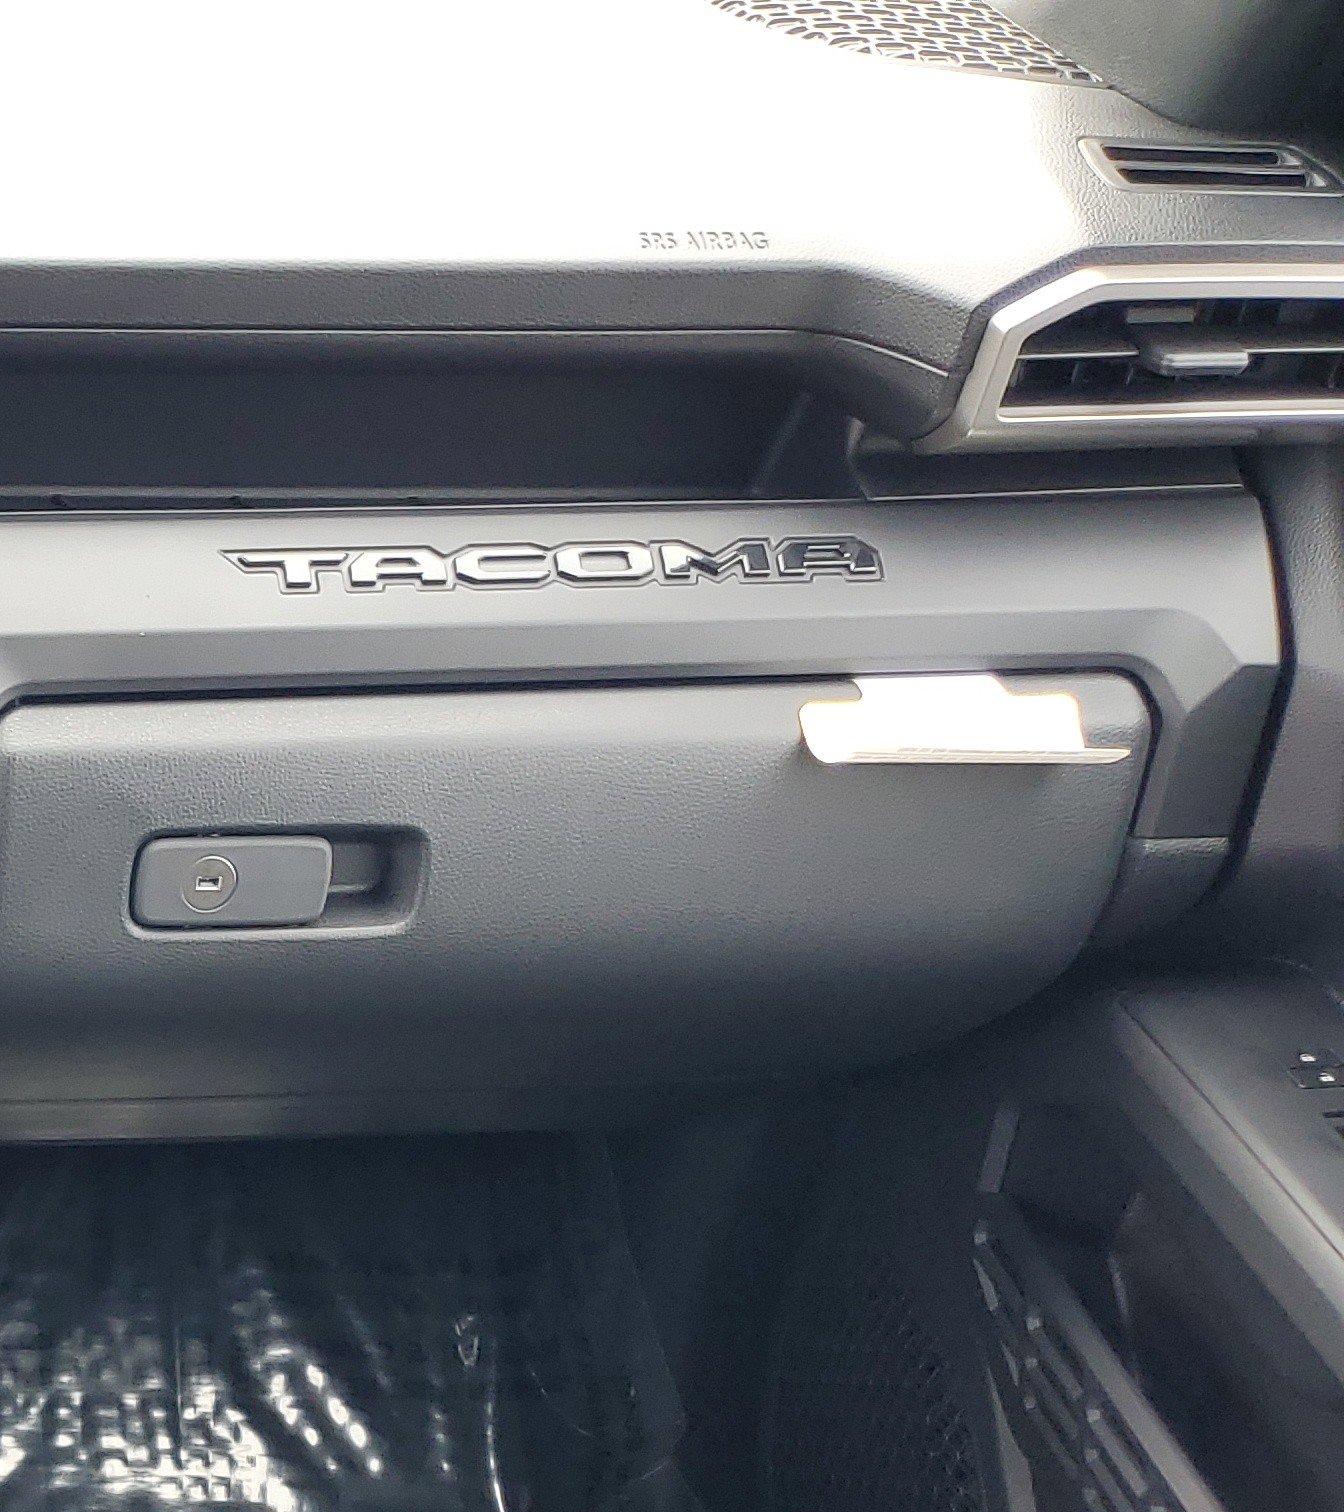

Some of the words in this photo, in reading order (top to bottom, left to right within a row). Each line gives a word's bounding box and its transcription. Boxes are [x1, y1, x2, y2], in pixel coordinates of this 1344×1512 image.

[639, 231, 677, 249] SRS
[687, 231, 769, 249] AIRBAG
[218, 536, 885, 595] TACOMA
